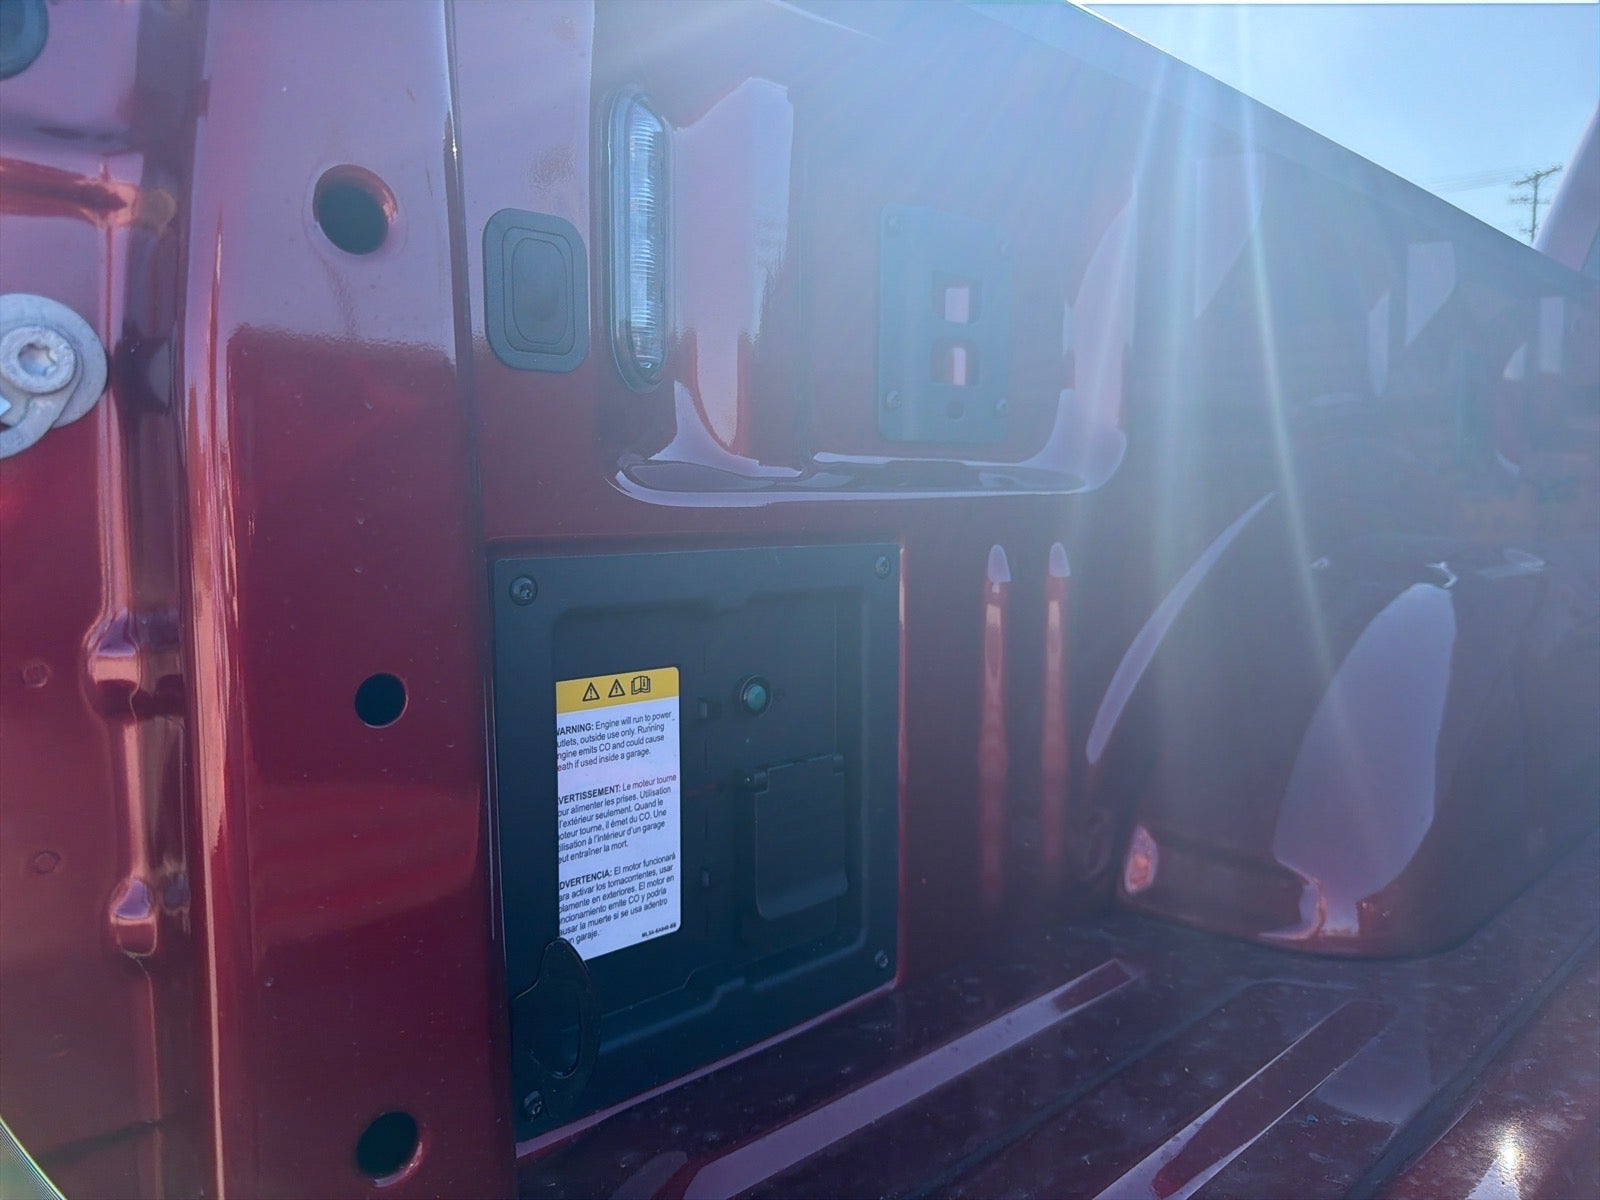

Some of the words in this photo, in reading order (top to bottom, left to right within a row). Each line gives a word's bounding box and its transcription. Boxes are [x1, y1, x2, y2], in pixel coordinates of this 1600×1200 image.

[557, 738, 578, 748] utlets,
[580, 732, 605, 744] outside
[621, 728, 635, 738] only.
[638, 723, 664, 734] Running
[596, 720, 619, 730] Engine
[621, 717, 631, 725] will
[652, 711, 671, 722] power
[558, 750, 577, 760] ngine
[579, 745, 597, 756] emits
[599, 743, 610, 752] CO
[612, 741, 624, 749] and
[626, 737, 644, 747] could
[645, 735, 664, 743] cause
[558, 761, 573, 771] eath
[581, 756, 597, 767] used
[599, 752, 619, 763] inside
[626, 748, 650, 760] garage.
[558, 808, 569, 817] our
[571, 801, 603, 814] alimenter
[605, 797, 615, 806] les
[616, 794, 638, 806] prises.
[640, 786, 671, 798] Utilisation
[559, 785, 620, 804] VERTISSEMENT:
[623, 782, 631, 791] Le
[632, 778, 655, 789] moteur
[656, 774, 676, 785] tourne
[560, 830, 578, 840] oteur
[580, 825, 604, 836] tourne,
[611, 818, 628, 828] émet
[629, 815, 638, 823] du
[639, 812, 651, 820] CO.
[653, 809, 666, 818] Une
[595, 806, 632, 820] seulement.
[634, 800, 656, 811] Quand
[559, 839, 586, 852] ilisation
[594, 829, 625, 843] l'intérieur
[627, 826, 641, 835] d'un
[643, 821, 665, 833] garage
[559, 854, 569, 864] eut
[570, 848, 602, 860] entraîner
[604, 844, 609, 852] la
[611, 840, 628, 850] mort.
[560, 870, 612, 890] DVERTENCIA:
[614, 867, 620, 875] El
[623, 862, 641, 873] motor
[643, 852, 676, 867] funcionará
[572, 885, 594, 898] activar
[596, 883, 606, 891] los
[608, 870, 657, 888] tomacorrientes,
[659, 865, 673, 874] usar
[560, 898, 590, 913] olamente
[602, 886, 637, 901] exteriores.
[646, 877, 664, 888] motor
[560, 905, 606, 924] ncionamiento
[608, 900, 626, 910] emite
[628, 894, 639, 904] CO
[646, 888, 666, 899] podría
[560, 924, 578, 936] ausar
[587, 915, 611, 928] muerte
[630, 906, 642, 915] usa
[644, 898, 667, 910] adentro
[576, 930, 600, 944] garaje.
